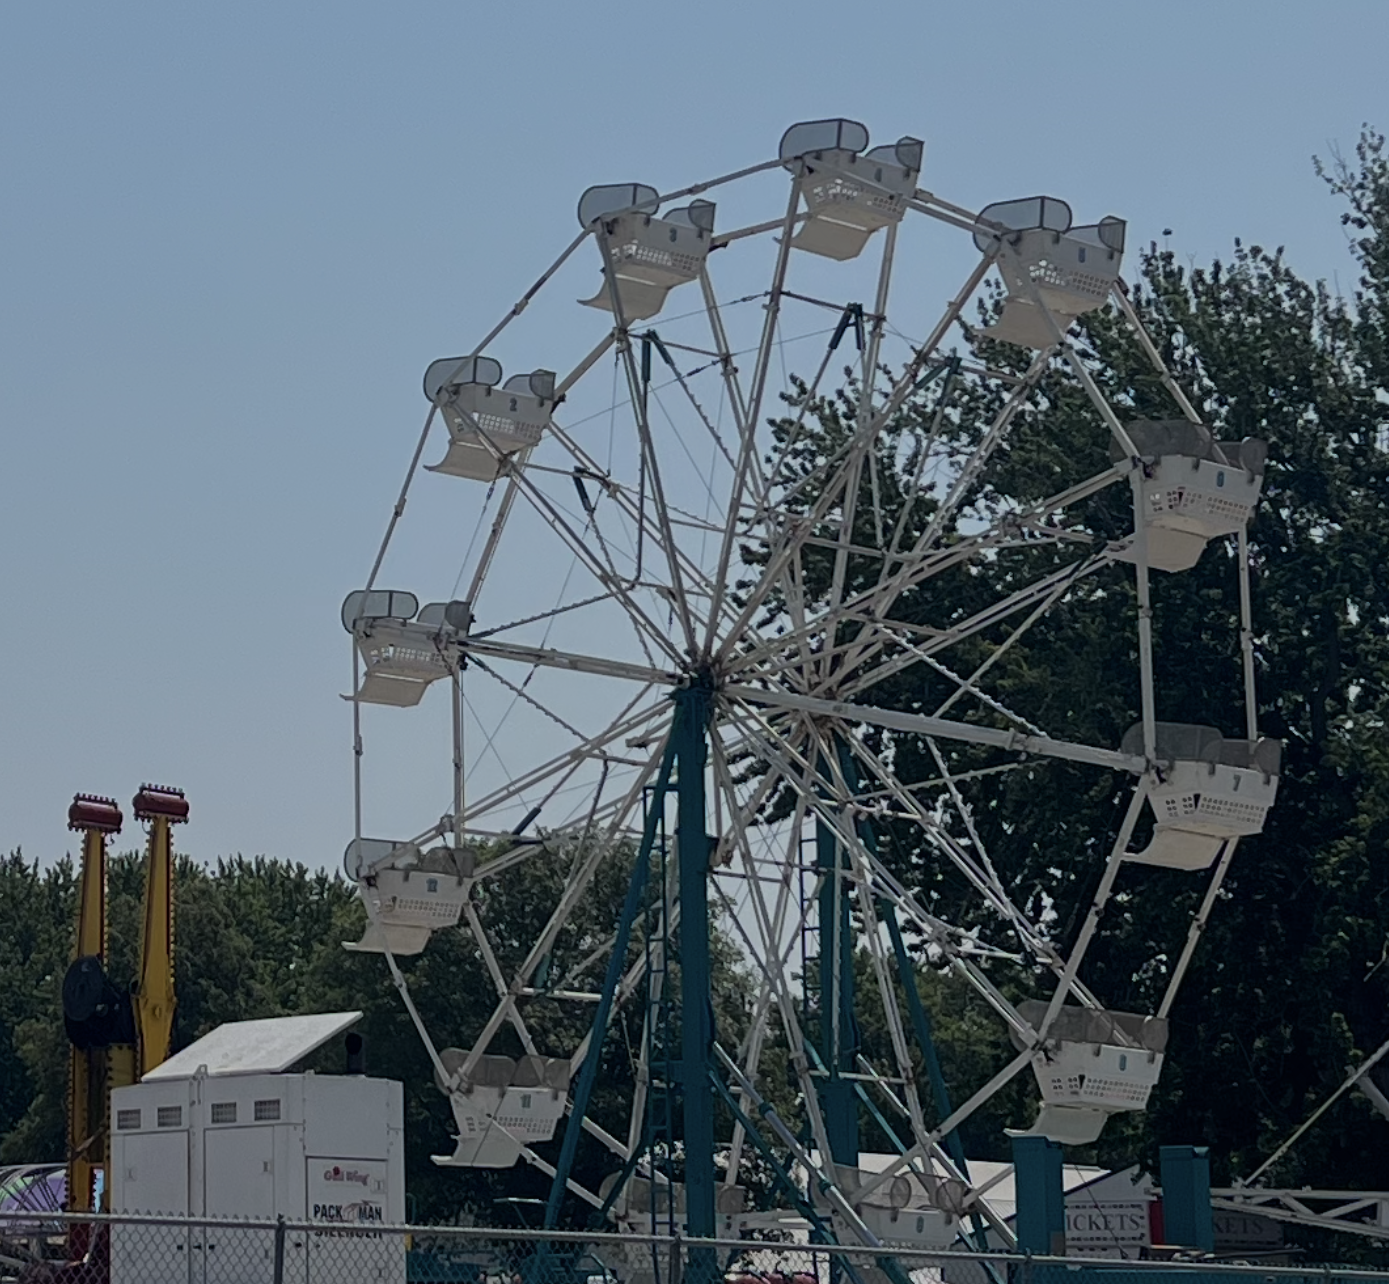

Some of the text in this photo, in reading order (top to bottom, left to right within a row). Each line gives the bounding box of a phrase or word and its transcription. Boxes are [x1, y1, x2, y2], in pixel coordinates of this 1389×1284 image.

[669, 227, 677, 243] 3
[510, 397, 518, 412] 2
[1233, 774, 1241, 792] 7
[314, 1204, 382, 1221] PACK MAN
[1066, 1213, 1140, 1231] ICKETS
[1213, 1216, 1264, 1235] KETS
